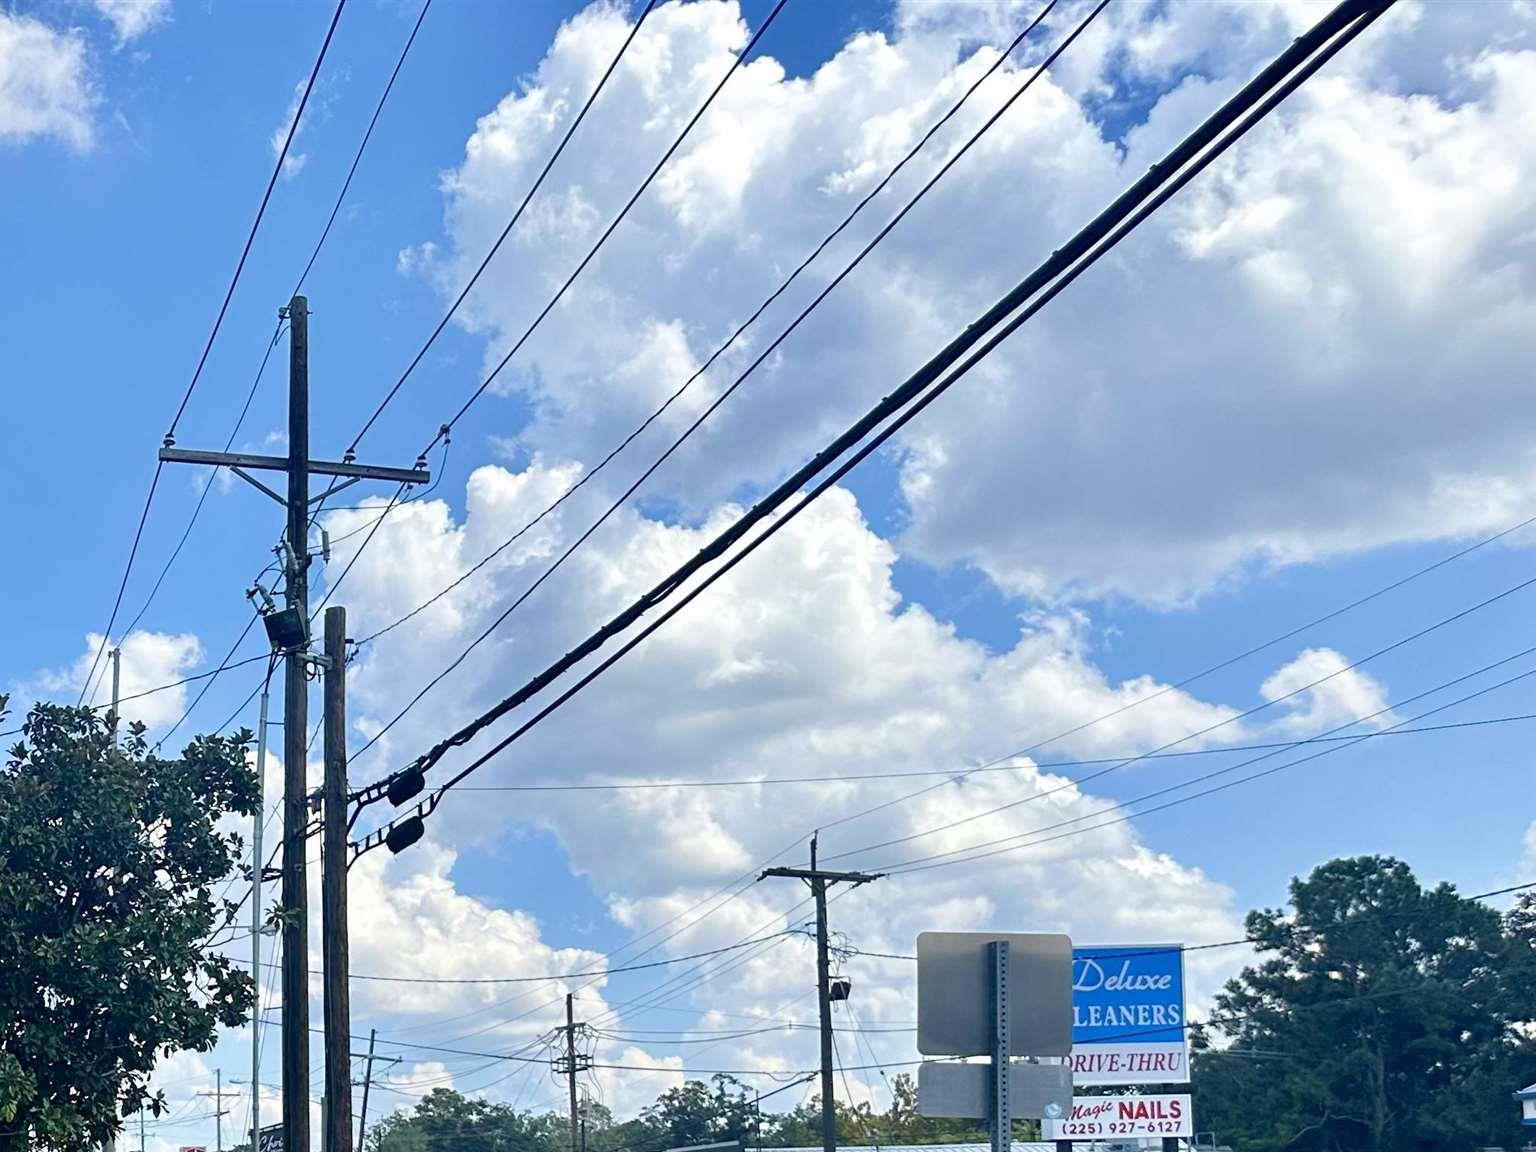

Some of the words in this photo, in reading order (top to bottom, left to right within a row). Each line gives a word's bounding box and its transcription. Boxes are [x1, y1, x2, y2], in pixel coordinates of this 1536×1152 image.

[1072, 958, 1172, 991] Deluxe
[1072, 1004, 1180, 1027] LEANERS
[1118, 1100, 1182, 1120] NAILS
[1062, 1122, 1103, 1135] (225)
[1109, 1121, 1182, 1134] 927-6127
